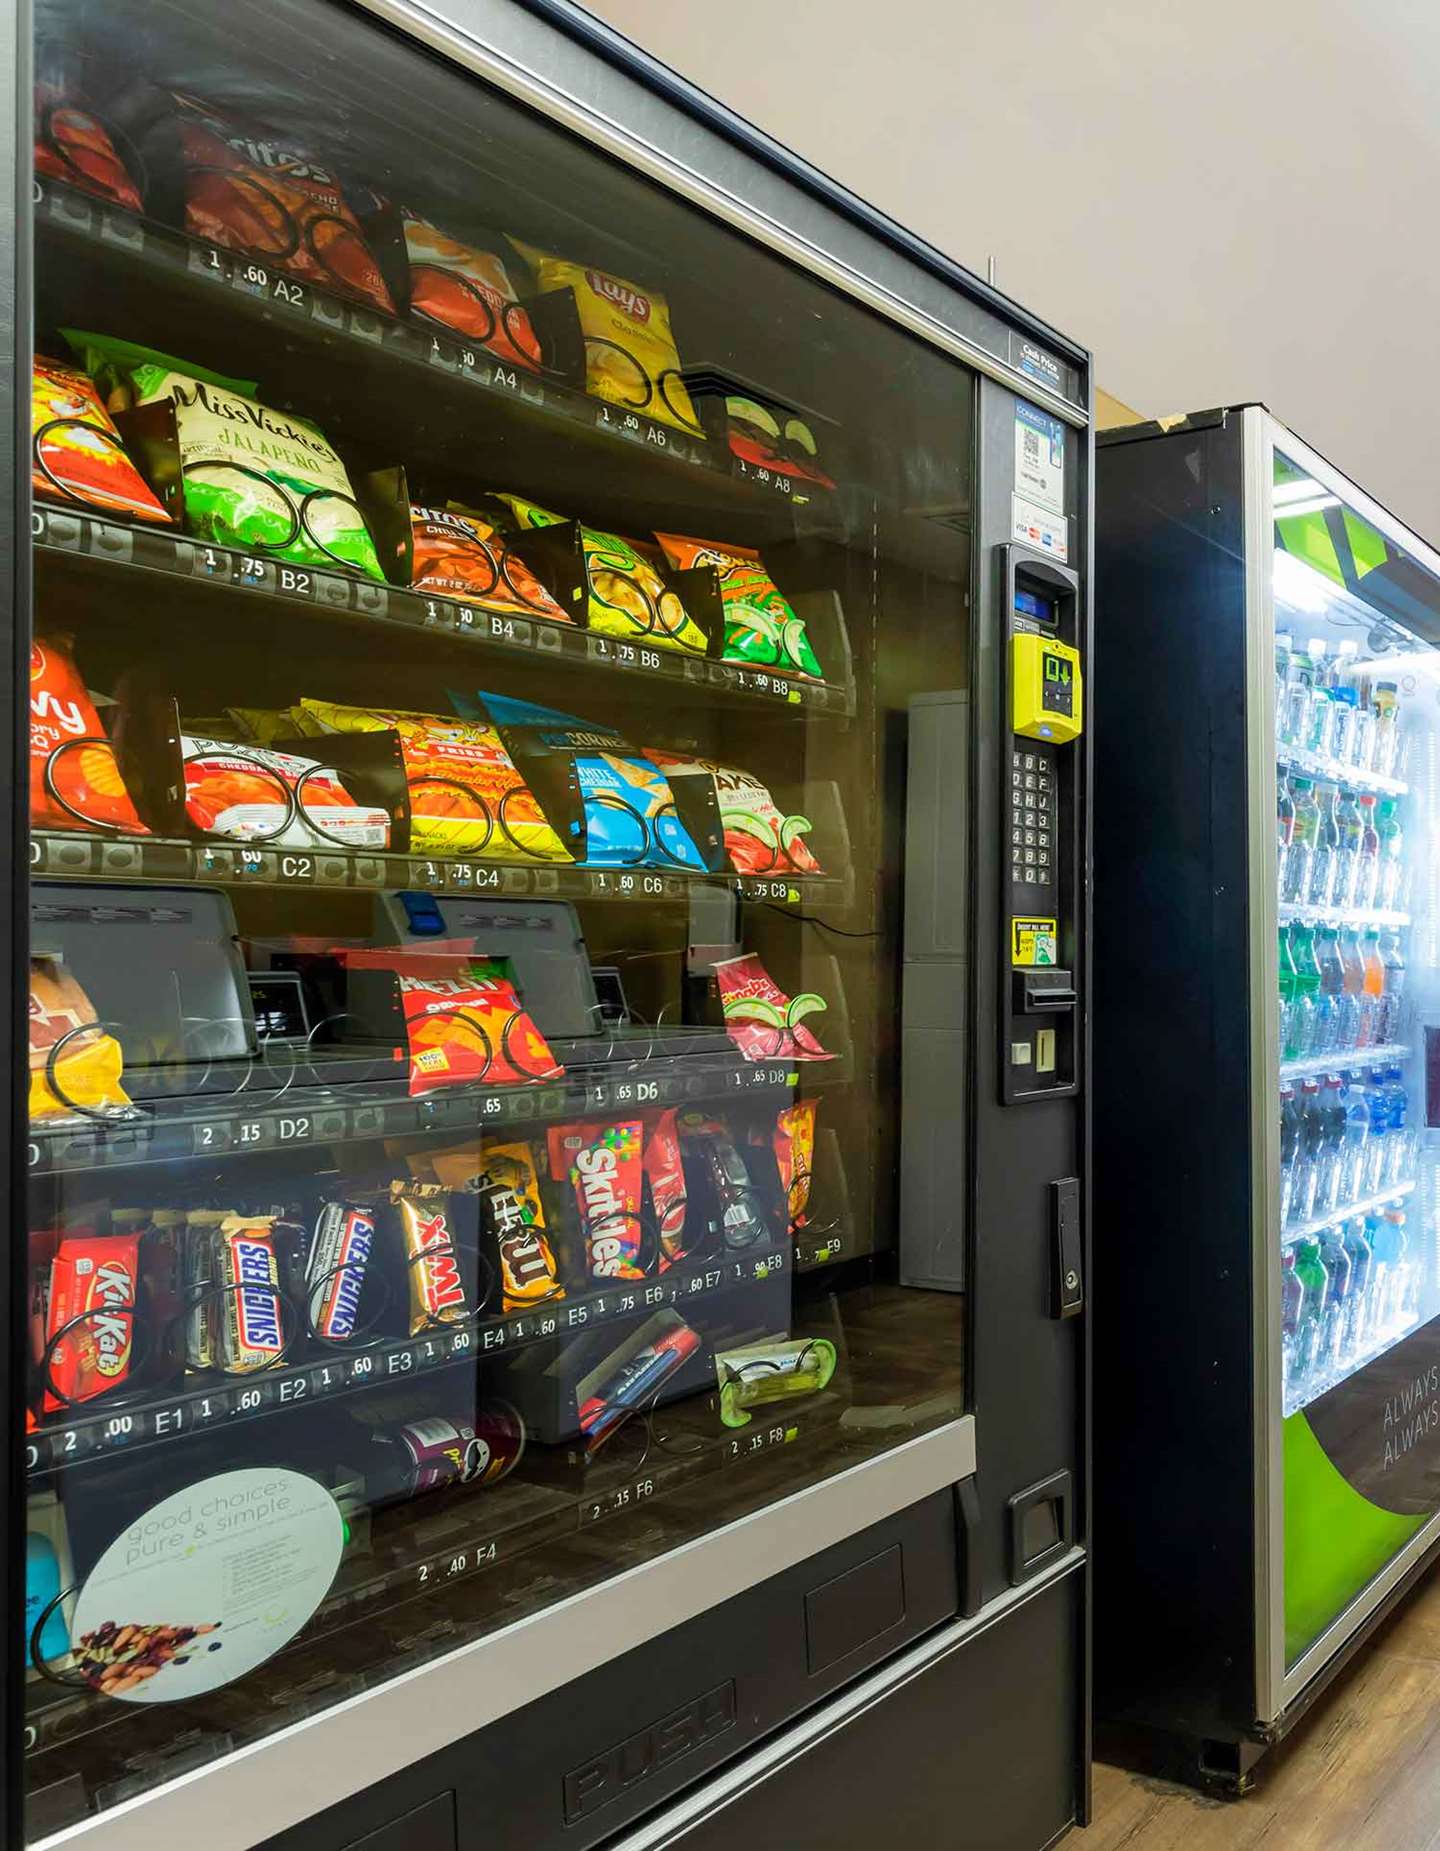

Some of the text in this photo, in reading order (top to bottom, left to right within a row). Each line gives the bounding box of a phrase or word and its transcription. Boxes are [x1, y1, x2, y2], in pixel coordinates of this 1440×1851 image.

[274, 281, 304, 307] A2
[494, 368, 518, 390] A4
[647, 426, 667, 447] A6
[775, 475, 791, 494] A8
[281, 570, 310, 594] B2
[492, 617, 515, 640] B4
[641, 650, 661, 670] B6
[773, 678, 789, 696] B8
[282, 856, 312, 878] C2
[476, 868, 500, 888] C4
[643, 876, 663, 894] C6
[770, 882, 787, 899] C8
[769, 1070, 786, 1085] D8
[637, 1082, 658, 1101] D6
[280, 1118, 309, 1140] D2
[575, 1148, 622, 1279] Skittles
[827, 1238, 841, 1254] E9
[768, 1255, 783, 1271] E8
[705, 1271, 722, 1288] E7
[645, 1286, 664, 1304] E6
[567, 1307, 588, 1326] E5
[93, 1314, 130, 1370] Kat
[483, 1329, 505, 1350] E4
[387, 1351, 413, 1374] E3
[279, 1379, 307, 1402] E2
[1383, 1365, 1440, 1432] ALWAYS
[155, 1412, 184, 1435] E1
[768, 1427, 784, 1444] F8
[1382, 1399, 1439, 1473] ALWAYS
[636, 1479, 654, 1500] F6
[127, 1478, 289, 1545] good choices
[125, 1496, 291, 1567] pure & simple
[476, 1543, 497, 1566] F4
